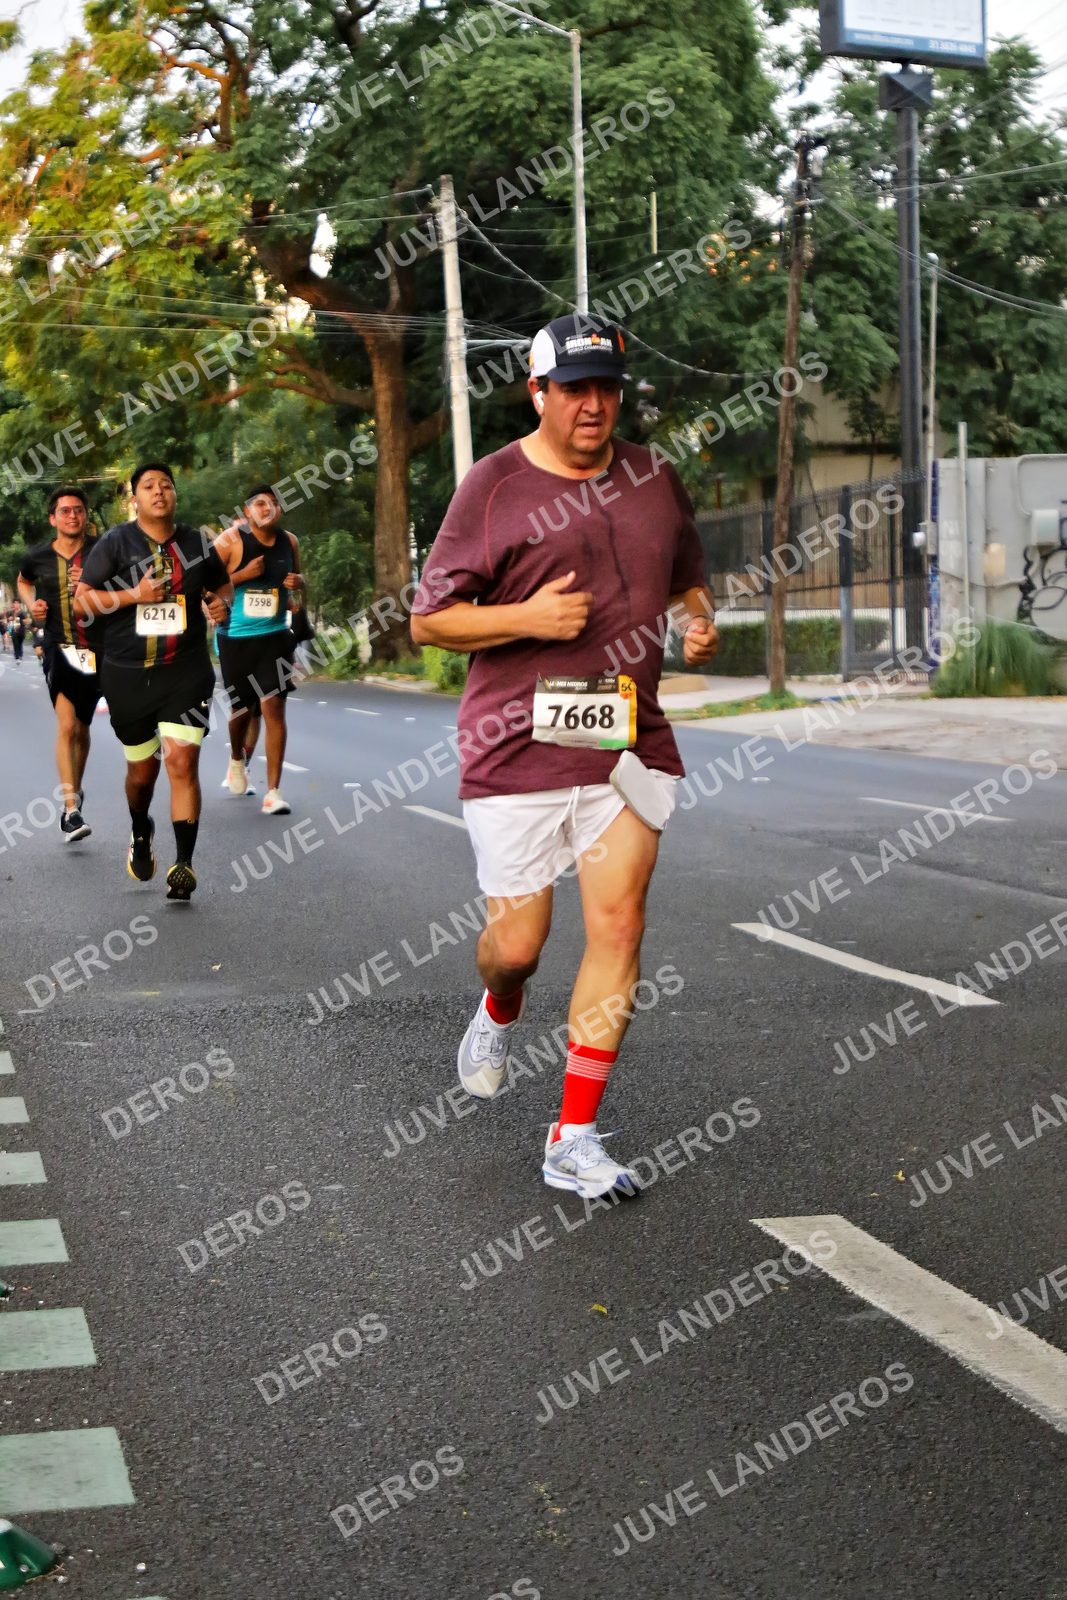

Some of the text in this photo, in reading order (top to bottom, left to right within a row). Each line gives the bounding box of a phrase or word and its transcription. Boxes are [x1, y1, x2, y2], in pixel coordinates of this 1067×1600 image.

[249, 597, 272, 607] 7598
[143, 607, 176, 621] 6214
[548, 704, 615, 730] 7668
